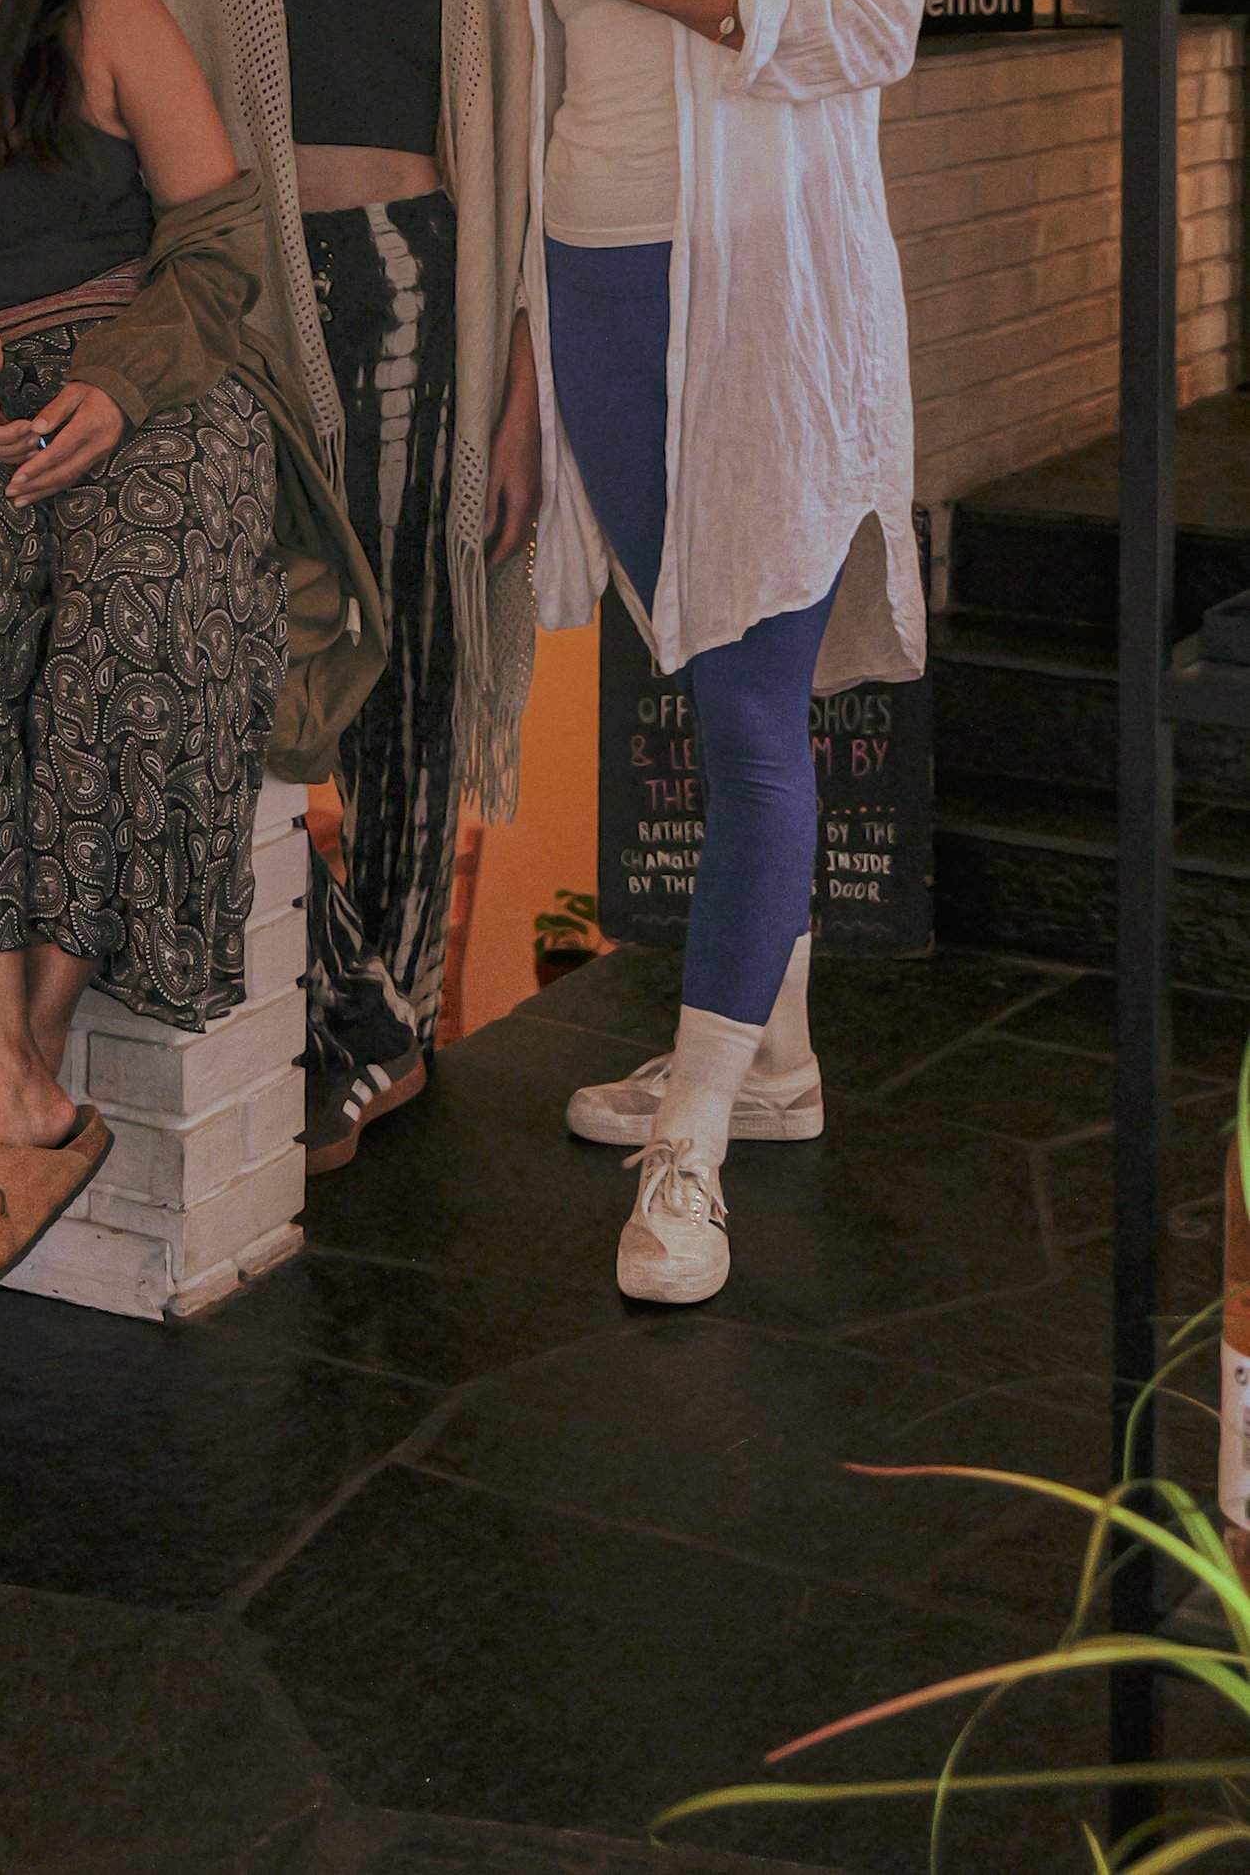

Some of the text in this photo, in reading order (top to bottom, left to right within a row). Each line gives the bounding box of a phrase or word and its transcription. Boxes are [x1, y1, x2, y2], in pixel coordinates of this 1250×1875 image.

[637, 693, 692, 729] OFF
[630, 734, 653, 767] &
[851, 738, 889, 777] BY
[638, 820, 896, 844] RATHER BY THE
[826, 850, 892, 875] INSIDE
[628, 875, 652, 894] BY
